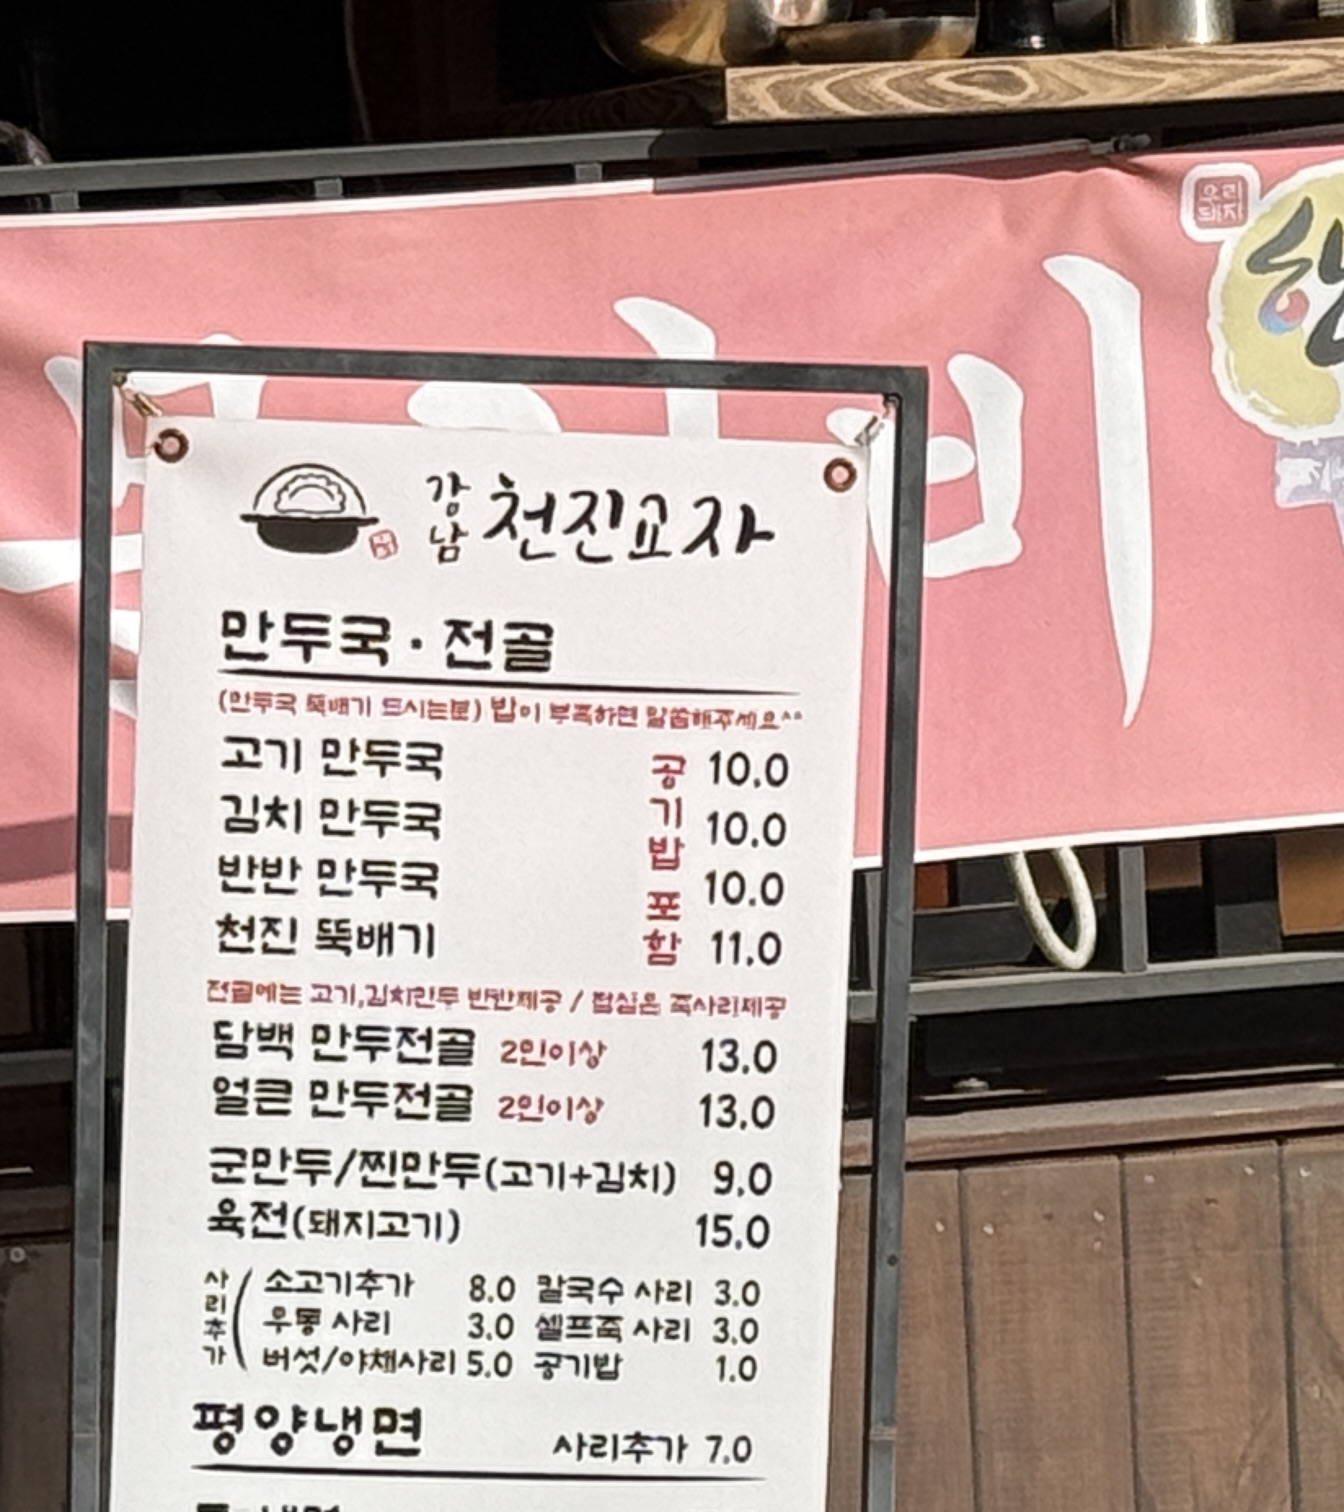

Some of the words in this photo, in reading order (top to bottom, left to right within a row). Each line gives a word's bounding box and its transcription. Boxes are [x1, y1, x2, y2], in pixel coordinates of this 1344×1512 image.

[426, 471, 469, 565] 강남
[482, 472, 775, 565] 천진교자
[221, 610, 391, 667] 만두국
[443, 618, 555, 672] 전골
[221, 735, 302, 774] 고기
[321, 737, 444, 781] 만두국
[709, 750, 789, 789] 10.0
[220, 794, 302, 835] 김치
[319, 797, 442, 841] 만두국
[706, 810, 787, 848] 10.0
[648, 753, 687, 871] 공기밥
[218, 854, 303, 896] 반반
[317, 858, 439, 901] 만두국
[704, 869, 785, 907] 10.0
[215, 912, 298, 956] 천진
[314, 917, 435, 959] 뚝배기
[711, 929, 782, 967] 11.0
[642, 891, 682, 966] 포함
[213, 1019, 294, 1062] 담백
[311, 1023, 476, 1067] 만두전골
[500, 1039, 608, 1070] 2인이상
[701, 1037, 778, 1075] 13.0
[212, 1076, 293, 1117] 얼큰
[309, 1079, 474, 1123] 만두전골
[498, 1094, 605, 1125] 2인이상
[699, 1093, 775, 1131] 13.0
[713, 1159, 773, 1198] 9.0
[207, 1197, 460, 1245] 육전(돼지고기)
[695, 1213, 770, 1251] 15.0
[264, 1268, 415, 1300] 소고기추가
[469, 1273, 516, 1304] 8.0
[536, 1274, 625, 1306] 칼국수
[634, 1279, 692, 1307] 사리
[714, 1279, 761, 1307] 3.0
[331, 1309, 390, 1336] 사리
[467, 1312, 514, 1341] 3.0
[632, 1316, 690, 1344] 사리
[712, 1316, 759, 1346] 3.0
[467, 1349, 513, 1379] 5.0
[533, 1351, 624, 1381] 공기밥
[716, 1354, 757, 1383] 1.0
[192, 1402, 422, 1458] 평양냉면
[552, 1430, 689, 1464] 사리추가
[705, 1434, 752, 1465] 7.0
